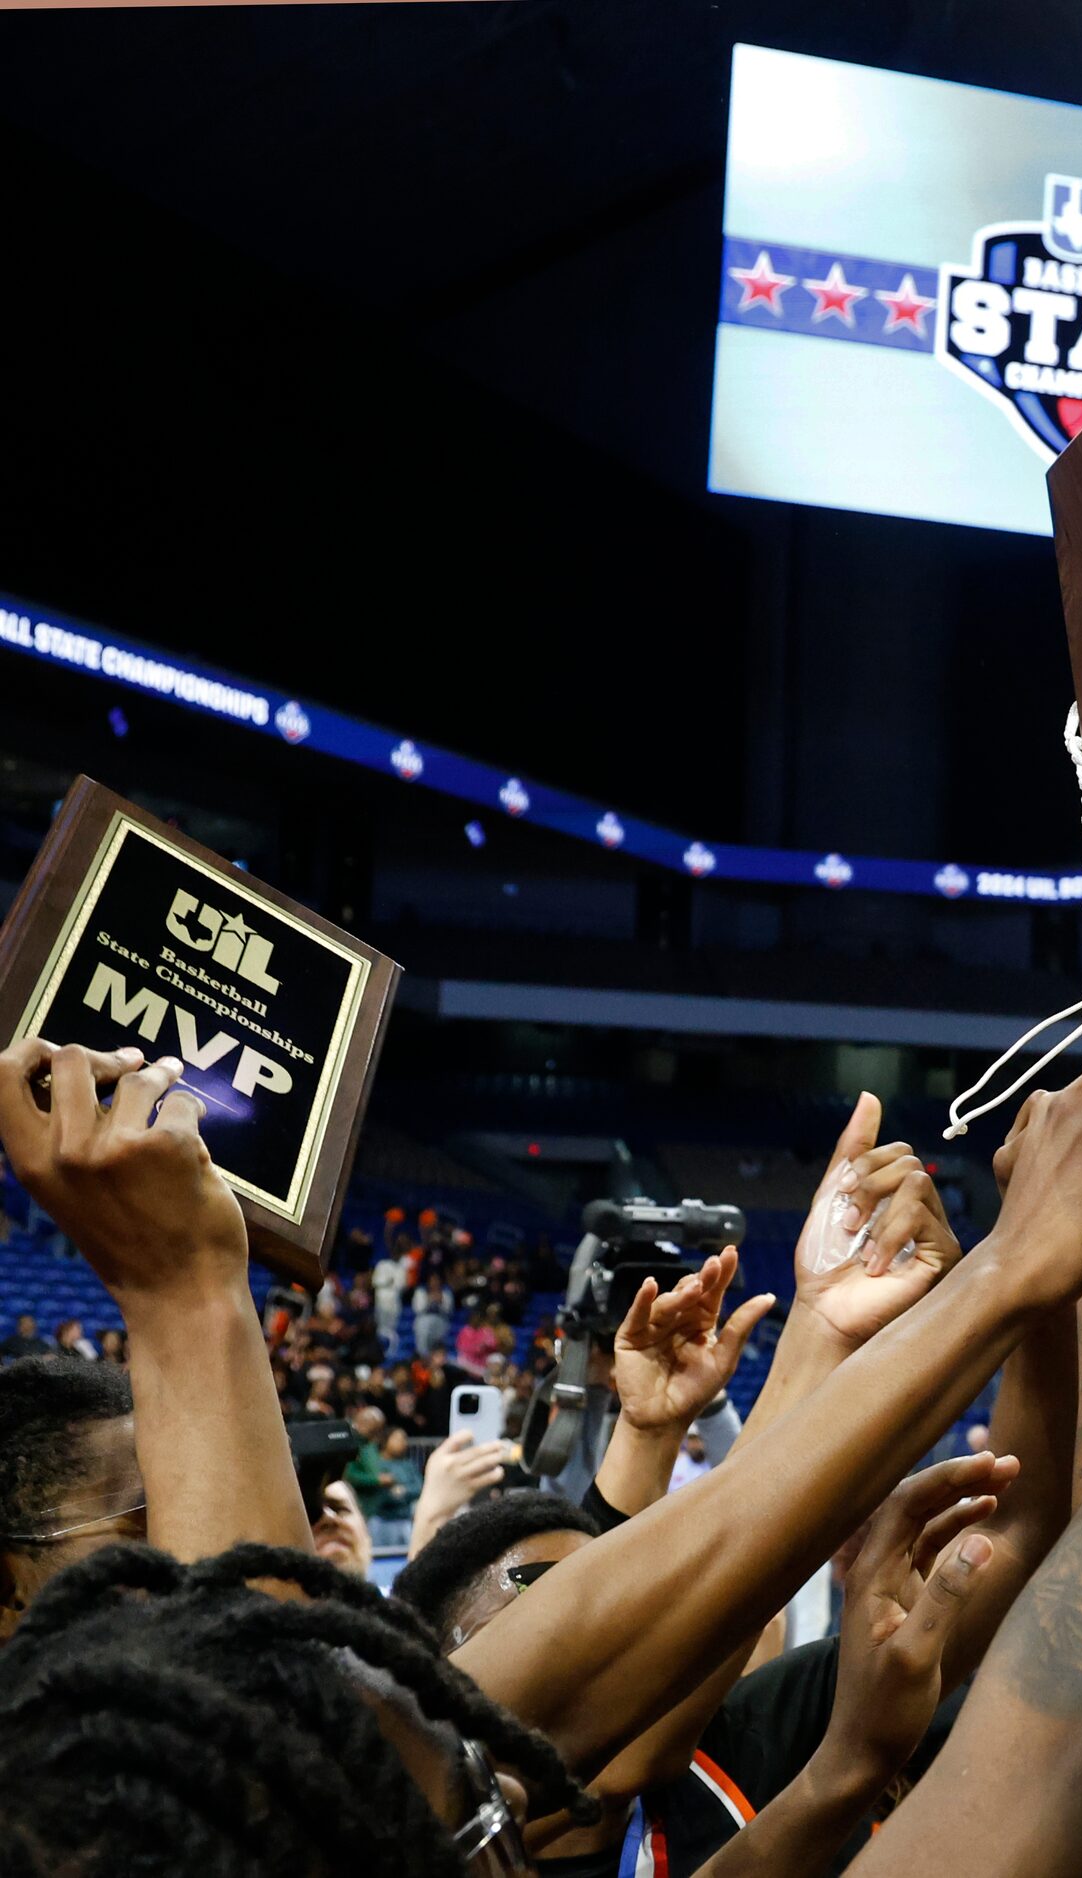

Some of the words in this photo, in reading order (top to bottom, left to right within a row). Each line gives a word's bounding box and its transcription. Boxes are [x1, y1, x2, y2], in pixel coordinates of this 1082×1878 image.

[34, 622, 103, 670] STATE
[101, 645, 269, 726] CHAMPIONSHIPS
[160, 947, 268, 1017] Basketball
[166, 888, 281, 995] UIL
[83, 962, 292, 1098] MVP
[97, 932, 150, 969] State
[156, 966, 315, 1064] Championships
